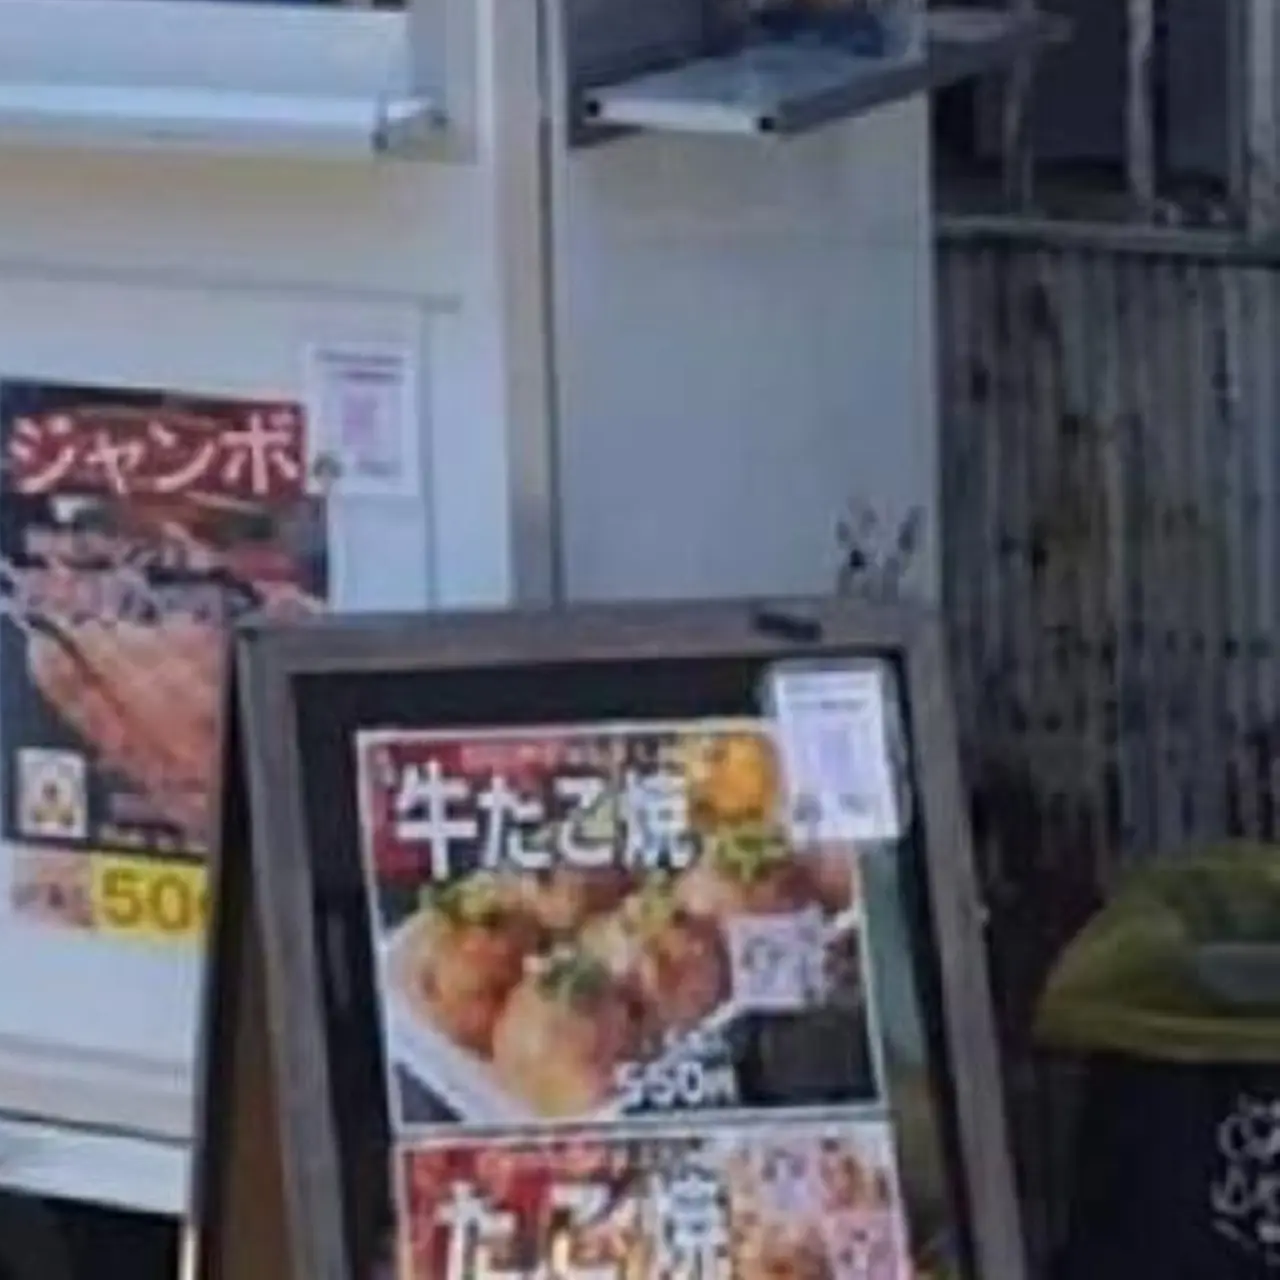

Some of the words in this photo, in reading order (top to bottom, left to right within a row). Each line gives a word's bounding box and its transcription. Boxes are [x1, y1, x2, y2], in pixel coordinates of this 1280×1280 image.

[10, 413, 302, 494] ジャンボ
[99, 868, 210, 935] 50
